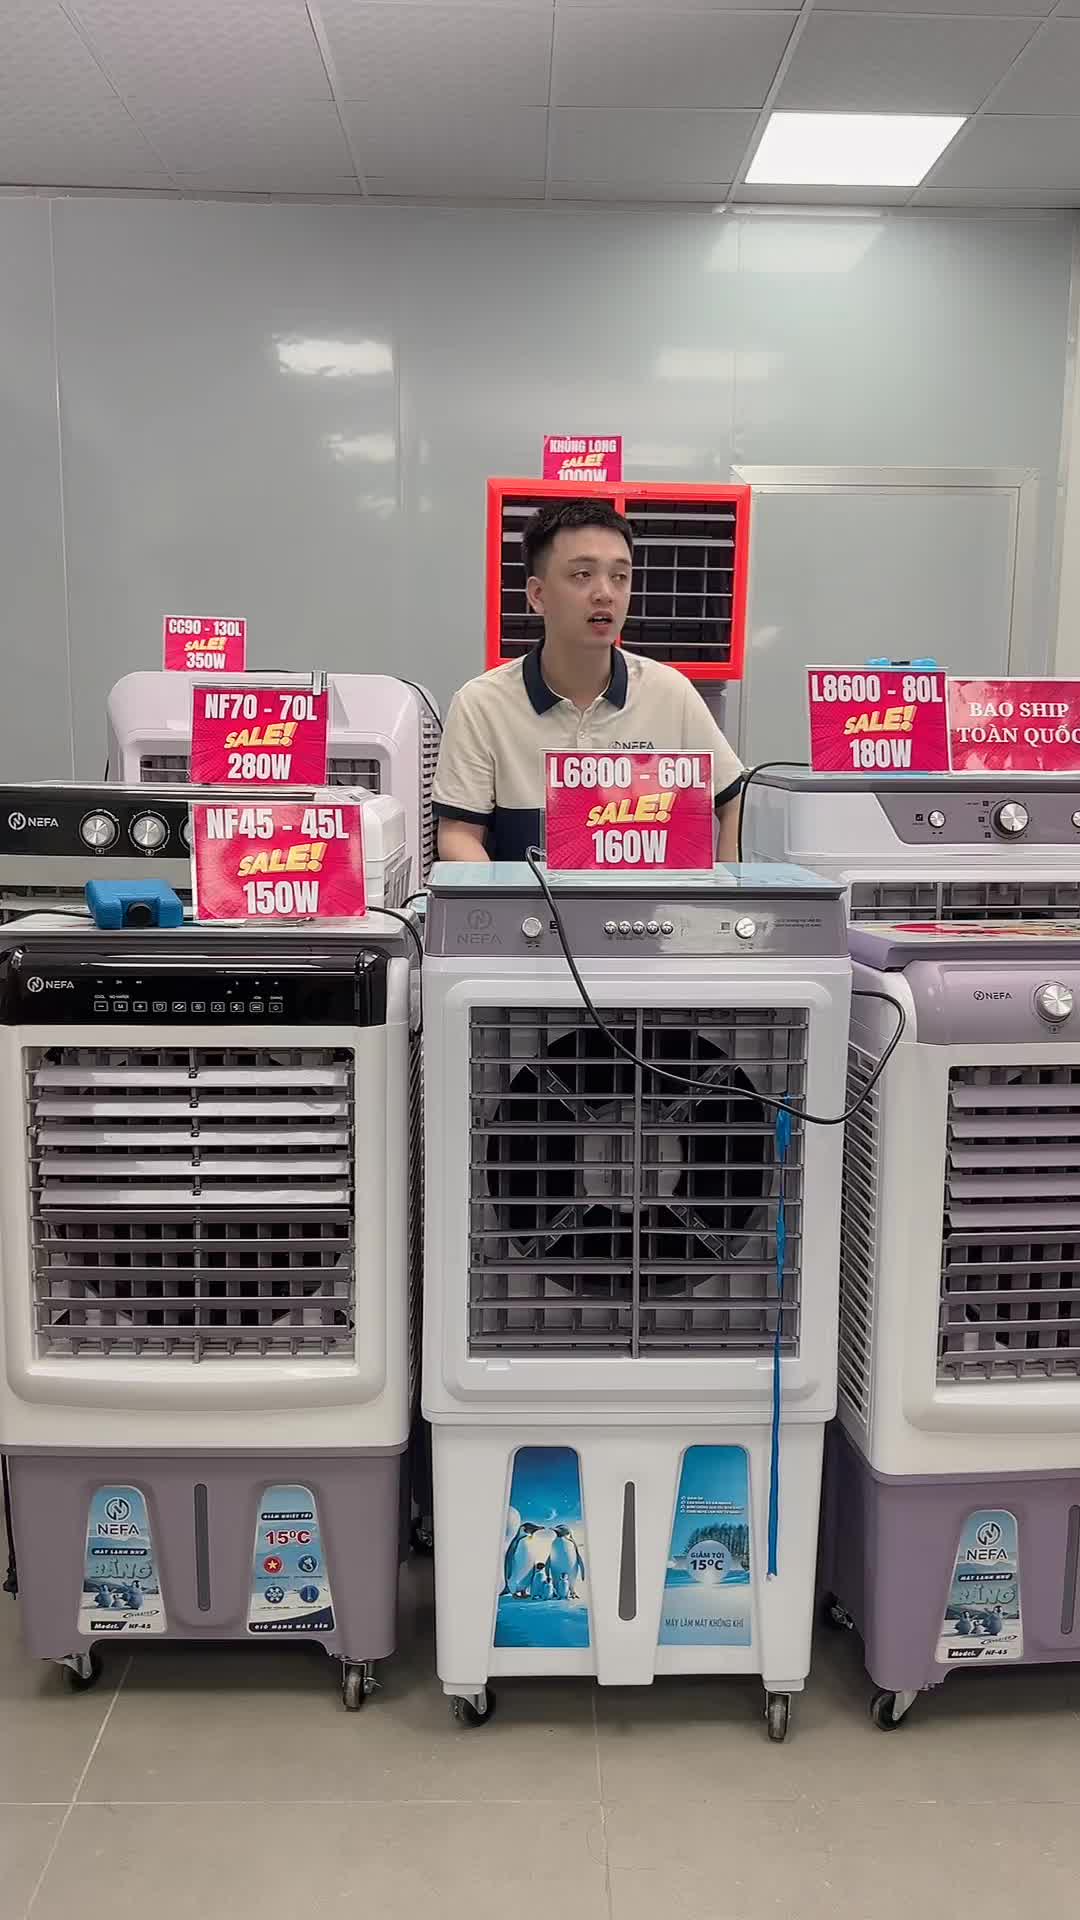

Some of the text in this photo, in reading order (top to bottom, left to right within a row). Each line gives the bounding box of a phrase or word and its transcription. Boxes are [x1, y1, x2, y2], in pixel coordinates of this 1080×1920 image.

[588, 439, 617, 453] LONG
[561, 452, 605, 469] SALE!
[557, 469, 608, 482] 1000W
[168, 619, 202, 635] CC90
[213, 621, 242, 636] 130L
[184, 637, 228, 652] SALE!
[186, 653, 226, 669] 350W
[811, 674, 881, 703] L8600
[902, 675, 944, 703] 80L
[205, 693, 258, 719] NF70
[279, 695, 318, 721] 70L
[968, 702, 1069, 718] BAO SHIP
[843, 704, 918, 735] SALE!
[223, 721, 298, 748] SALE!
[957, 724, 1018, 743] TOÀN
[849, 738, 912, 768] 180W
[227, 752, 292, 780] 280W
[550, 756, 633, 789] L6800
[658, 757, 706, 789] 60L
[586, 791, 678, 827] SALE!
[28, 817, 59, 827] NEFA
[206, 808, 274, 840] NF45
[300, 808, 350, 840] 45L
[591, 829, 668, 864] 160W
[237, 842, 328, 877] SALE!
[242, 880, 320, 915] 150W
[456, 933, 503, 945] NEFA
[45, 980, 75, 989] NEFA
[985, 992, 1013, 1000] NEFA
[97, 1523, 140, 1535] NEFA
[966, 1549, 1008, 1560] NEFA
